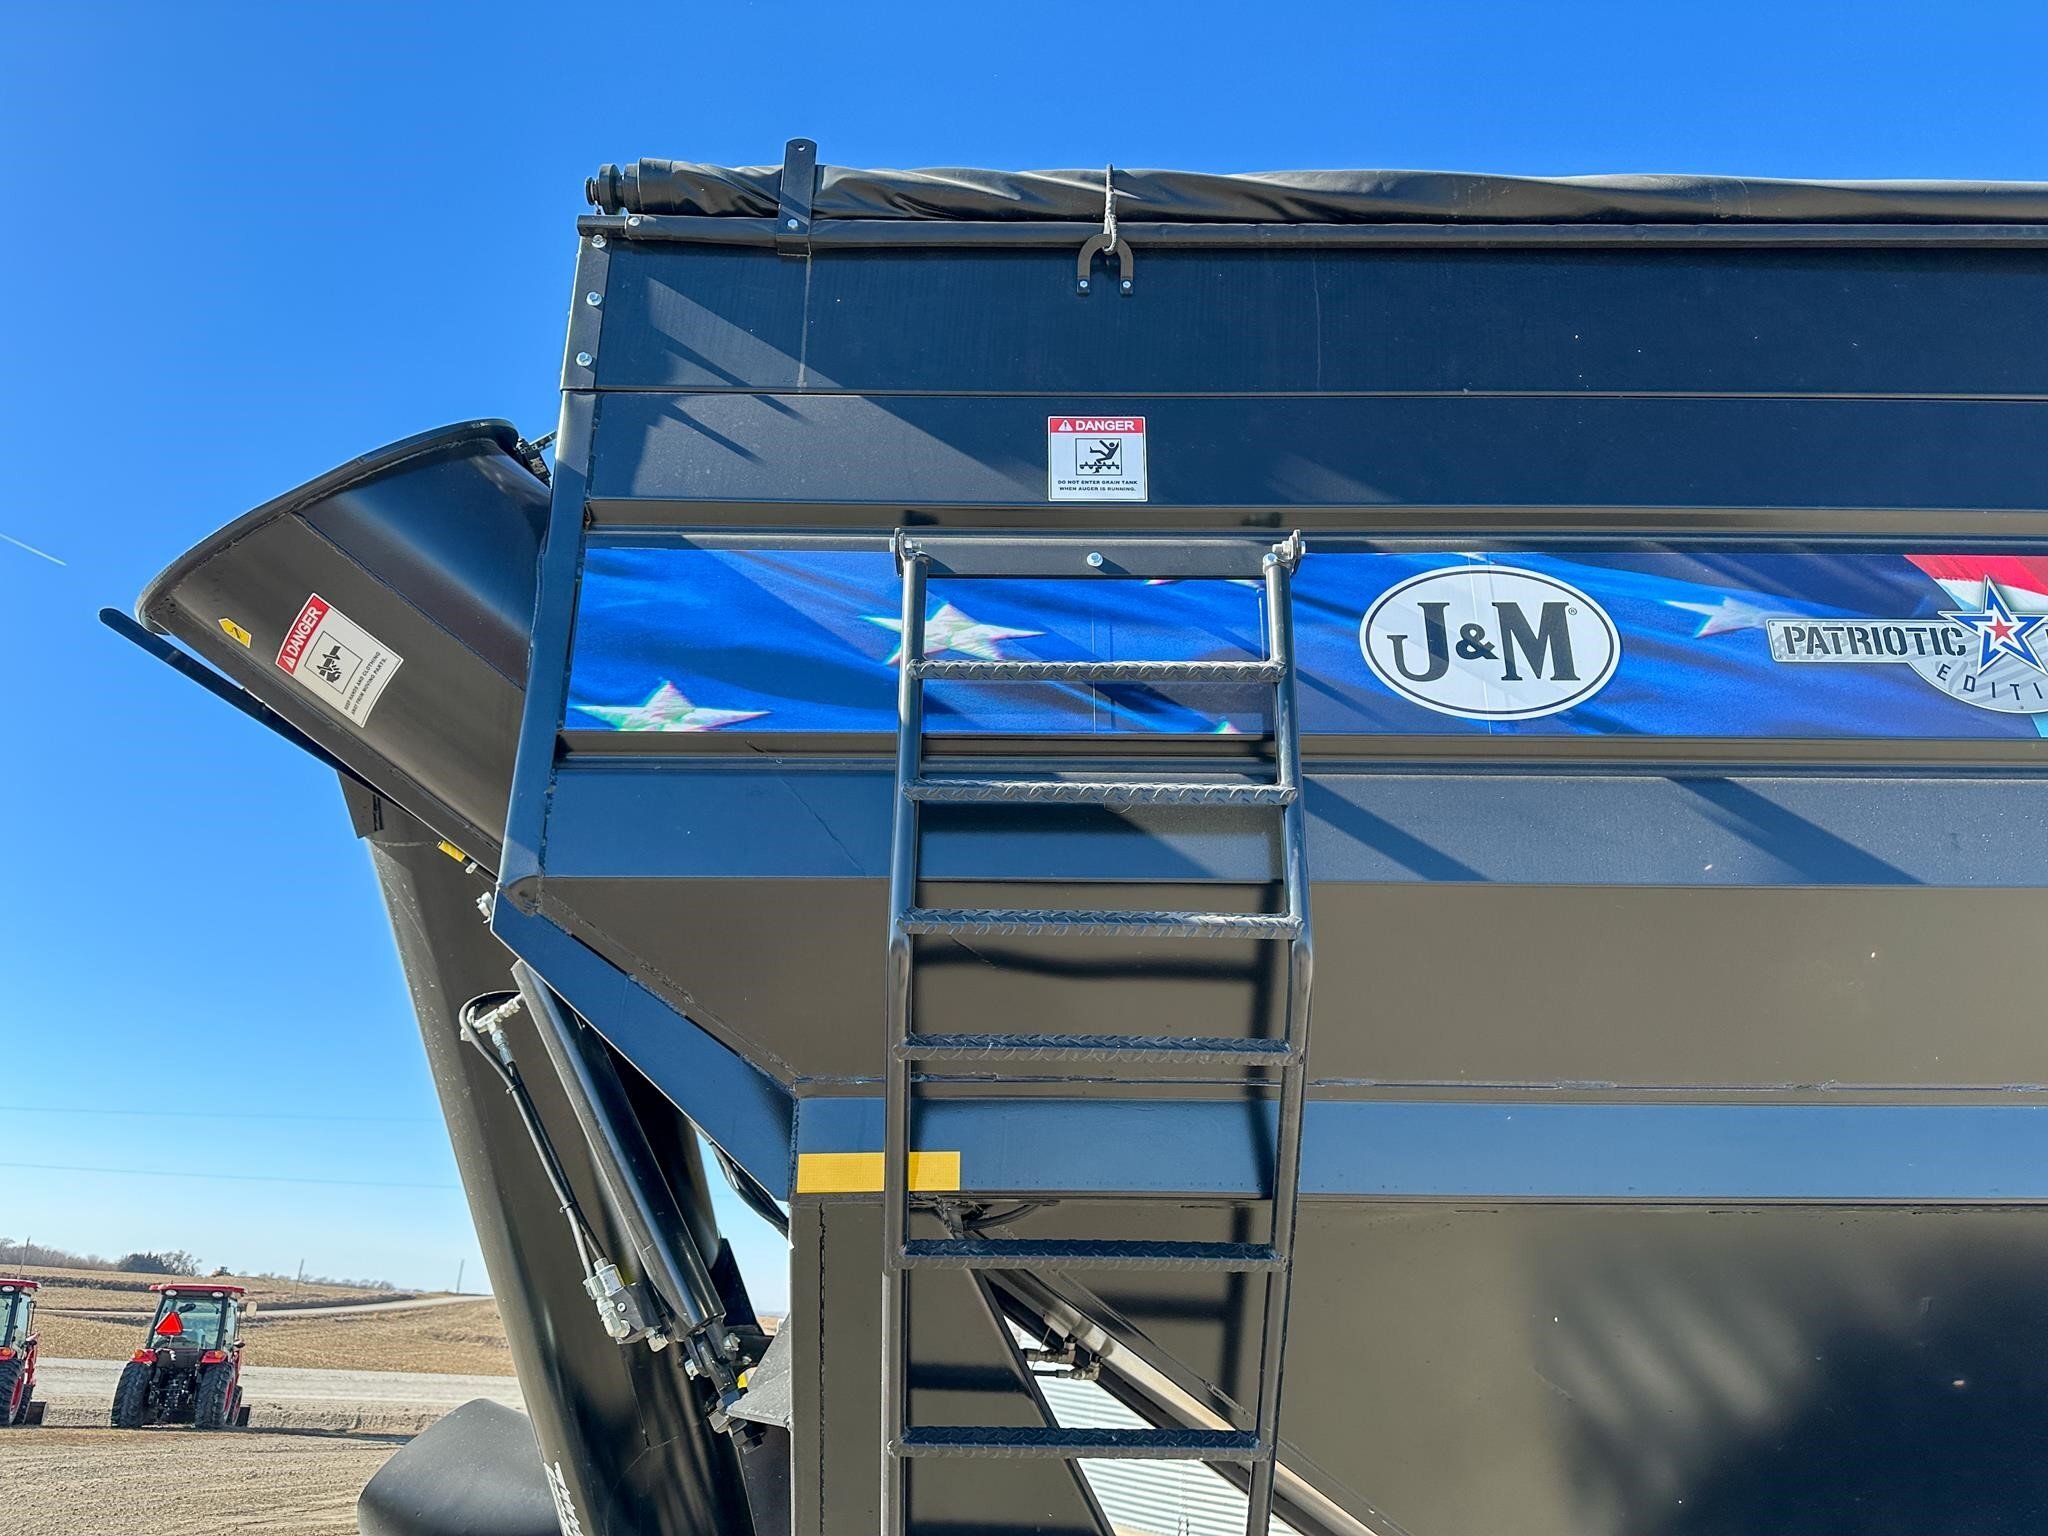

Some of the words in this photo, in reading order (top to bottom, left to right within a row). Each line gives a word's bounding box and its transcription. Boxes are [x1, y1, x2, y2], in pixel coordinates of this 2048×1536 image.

[1075, 420, 1135, 431] DANGER
[287, 606, 323, 656] DANGER
[1387, 601, 1581, 682] J&M
[1783, 626, 1966, 657] PATRIOTIC
[356, 675, 364, 686] AND
[362, 651, 381, 677] CLOTHING
[362, 674, 376, 693] MOVING
